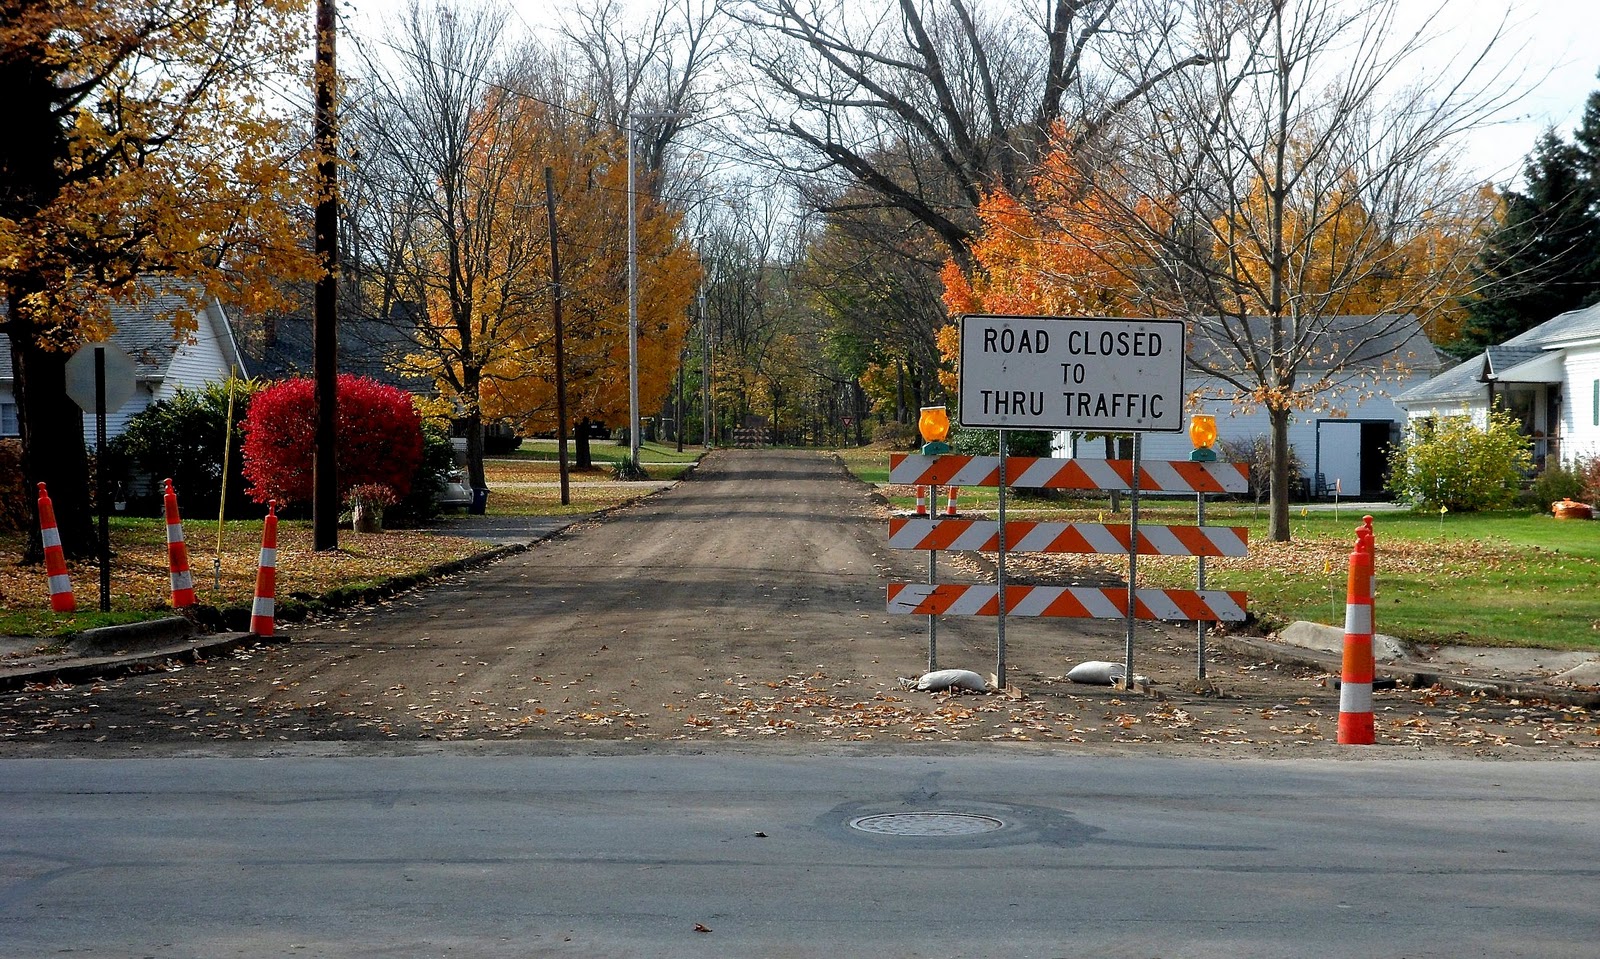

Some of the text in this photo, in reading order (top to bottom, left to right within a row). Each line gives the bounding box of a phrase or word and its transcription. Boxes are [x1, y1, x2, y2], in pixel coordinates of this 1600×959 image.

[984, 328, 1162, 357] ROAD CLOSED
[1061, 363, 1085, 385] TO
[981, 390, 1164, 419] THRU TRAFFIC
